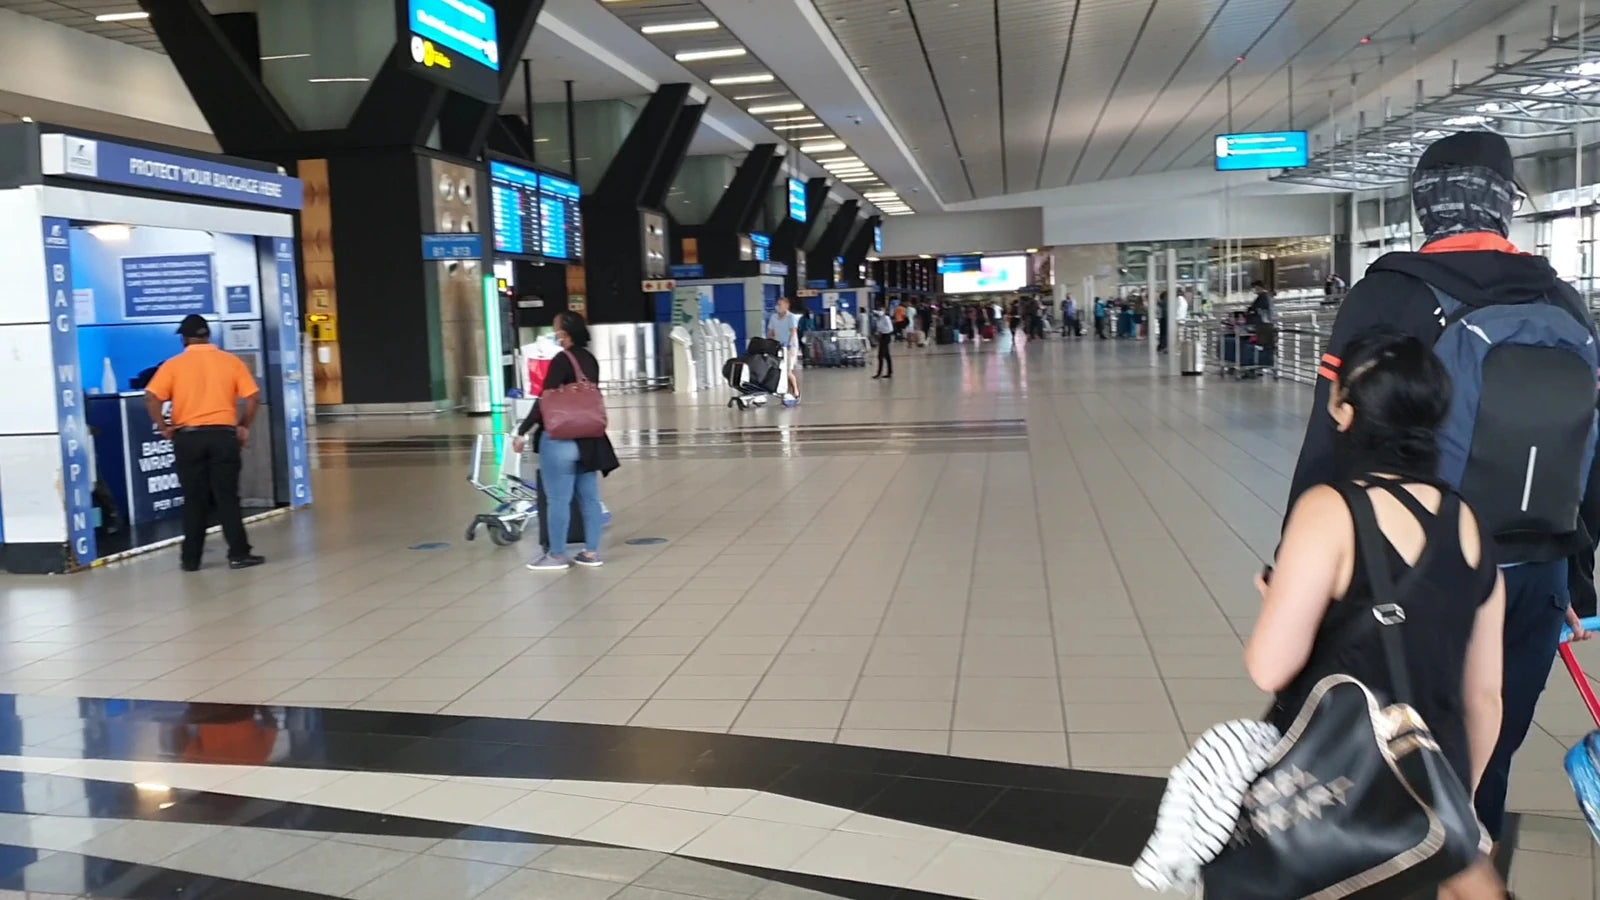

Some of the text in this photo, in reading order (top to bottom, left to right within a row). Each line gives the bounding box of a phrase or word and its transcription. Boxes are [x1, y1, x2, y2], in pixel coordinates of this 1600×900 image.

[130, 158, 283, 198] PROTECT YOUR BAGGAGE HERE
[53, 264, 70, 333] BAG
[281, 273, 293, 326] BAG
[58, 365, 88, 555] WRAPPING
[139, 454, 176, 472] WRAP
[142, 440, 174, 456] BAGG
[148, 473, 181, 493] R100.
[153, 499, 172, 511] PER
